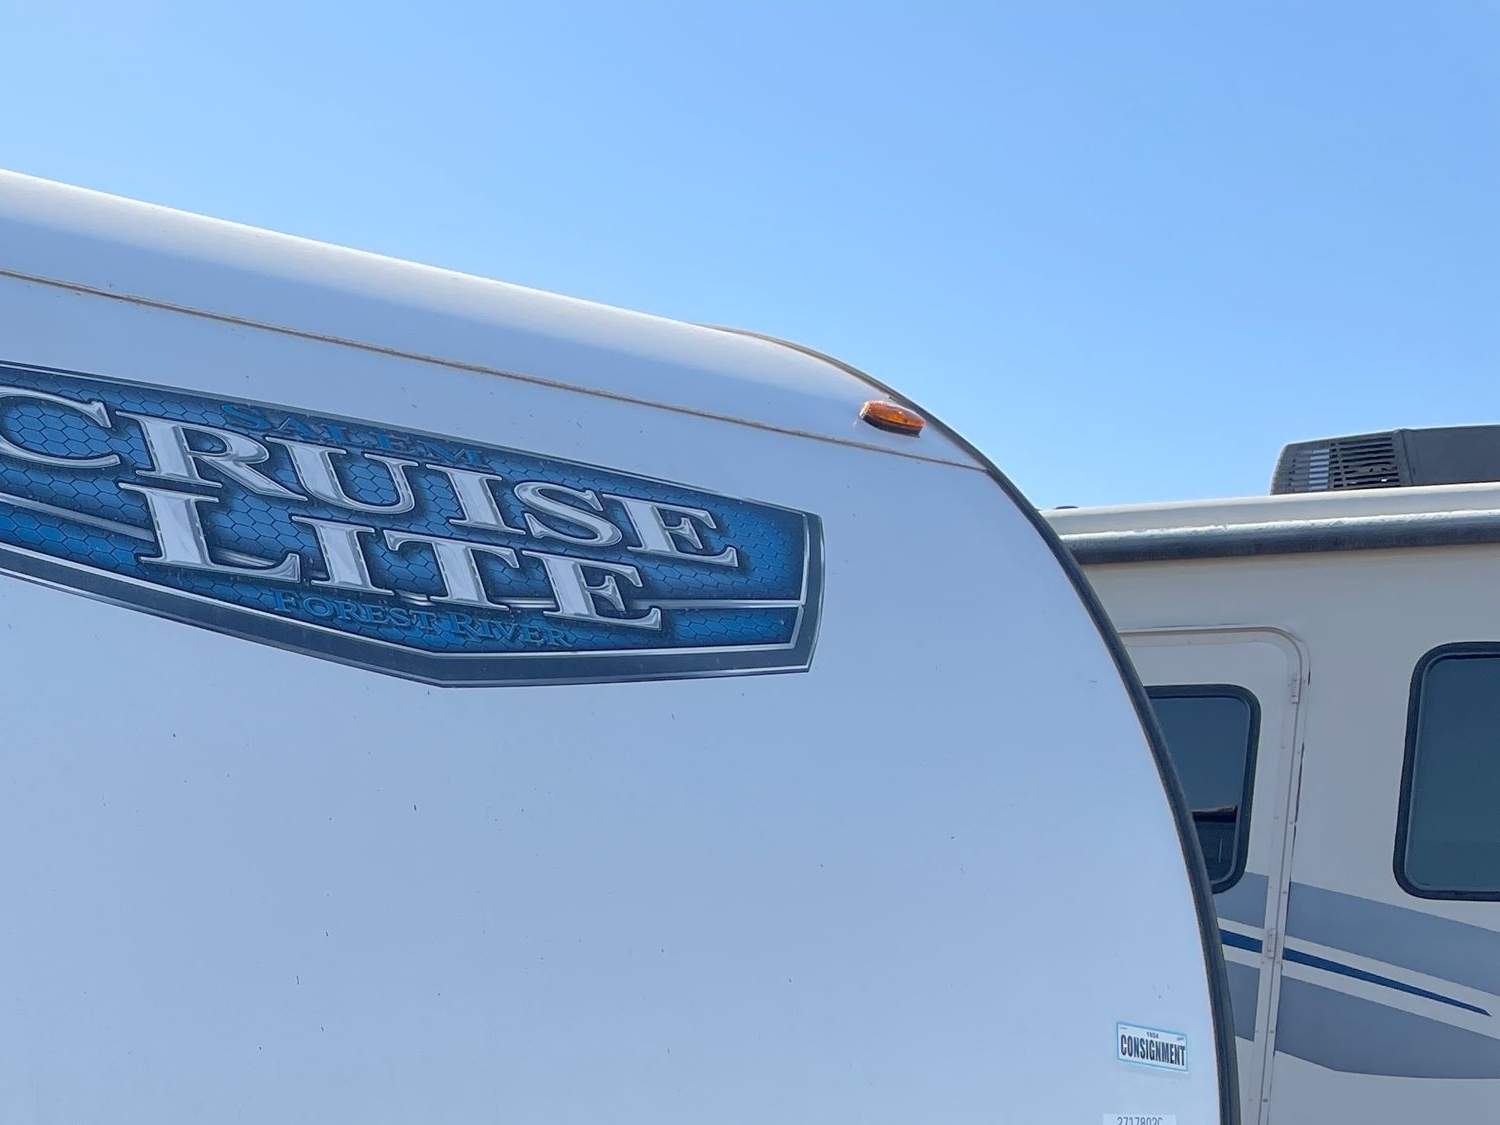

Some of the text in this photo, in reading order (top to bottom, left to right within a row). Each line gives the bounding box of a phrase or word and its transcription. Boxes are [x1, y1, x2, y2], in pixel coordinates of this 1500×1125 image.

[116, 480, 666, 632] LITE
[269, 588, 575, 649] FOREST RIVER
[1120, 1034, 1186, 1067] CONSIGNMENT
